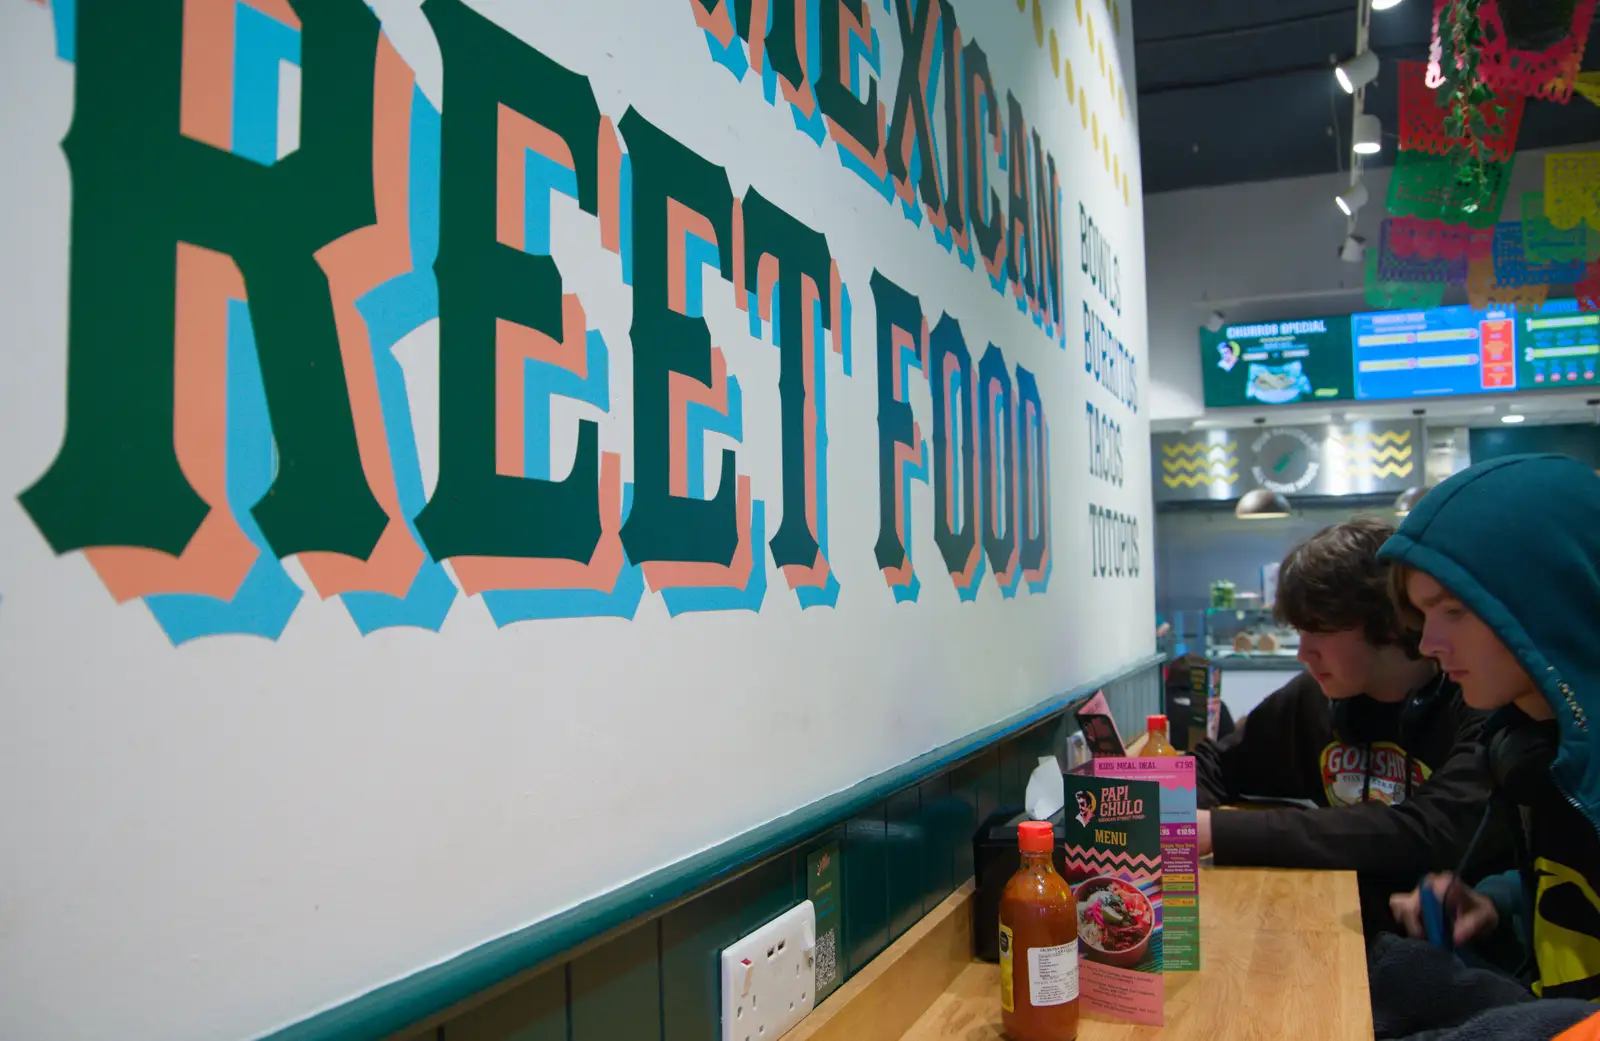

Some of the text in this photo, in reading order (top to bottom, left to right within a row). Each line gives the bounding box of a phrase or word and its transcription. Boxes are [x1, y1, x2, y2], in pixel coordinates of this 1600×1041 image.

[1079, 201, 1121, 316] BOWLS
[1226, 320, 1327, 339] CHURROS SPECIAL
[1083, 300, 1138, 414] BURRITOS
[869, 266, 1052, 603] FOOD
[1086, 400, 1124, 488] TACOS
[1089, 503, 1140, 578] TOTOPOS
[1098, 762, 1115, 770] KIDS
[1117, 762, 1137, 770] MEAL
[1139, 761, 1157, 769] DEAL
[1100, 799, 1143, 817] CHULO
[1101, 785, 1129, 803] PAPI
[1095, 829, 1128, 846] MENU
